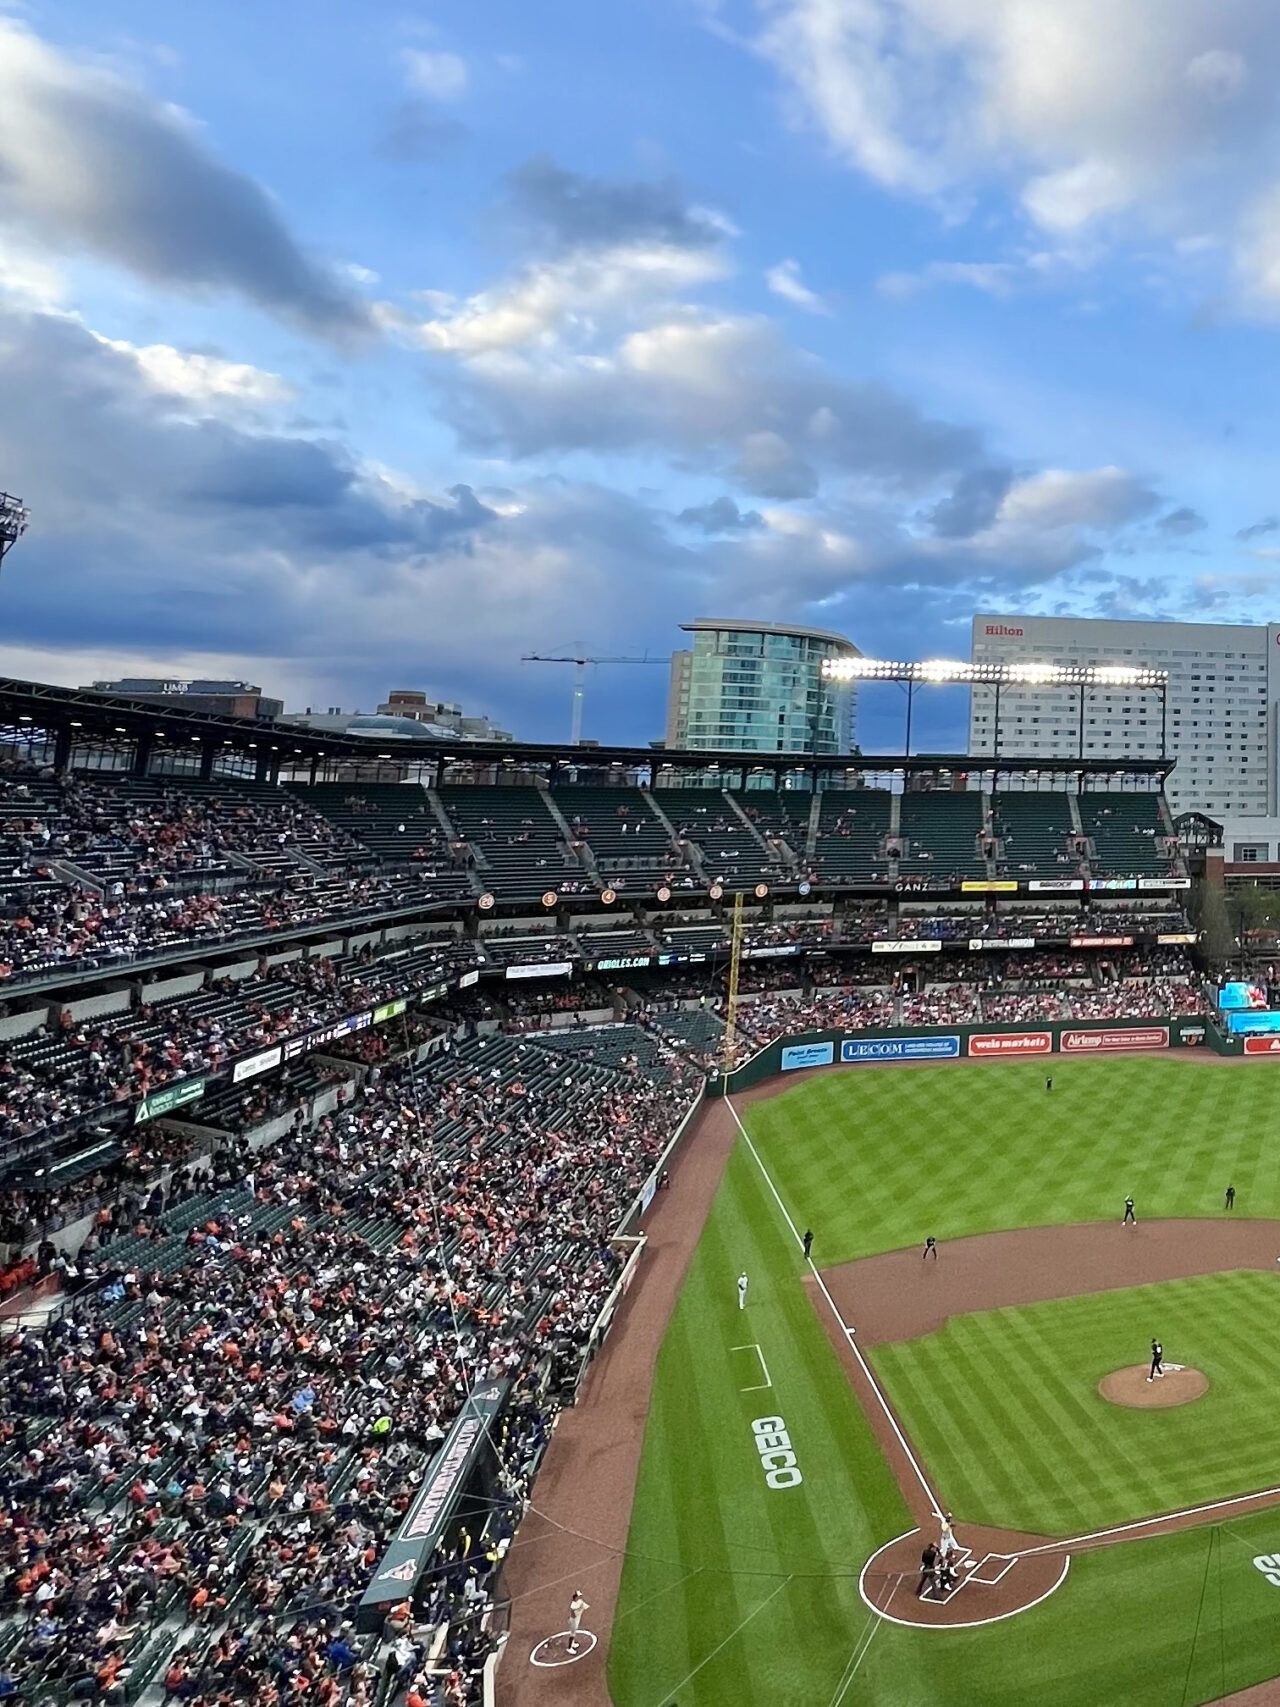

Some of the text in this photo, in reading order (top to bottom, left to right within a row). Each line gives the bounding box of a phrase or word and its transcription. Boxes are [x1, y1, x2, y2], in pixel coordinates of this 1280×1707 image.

[985, 625, 1023, 636] Hilton
[895, 883, 929, 892] GANZ
[597, 958, 650, 970] ORIOLES.COM
[975, 1036, 1045, 1049] weis markets
[1068, 1033, 1102, 1046] Airtemp
[848, 1044, 904, 1056] LECOM
[752, 1416, 802, 1489] GEICO
